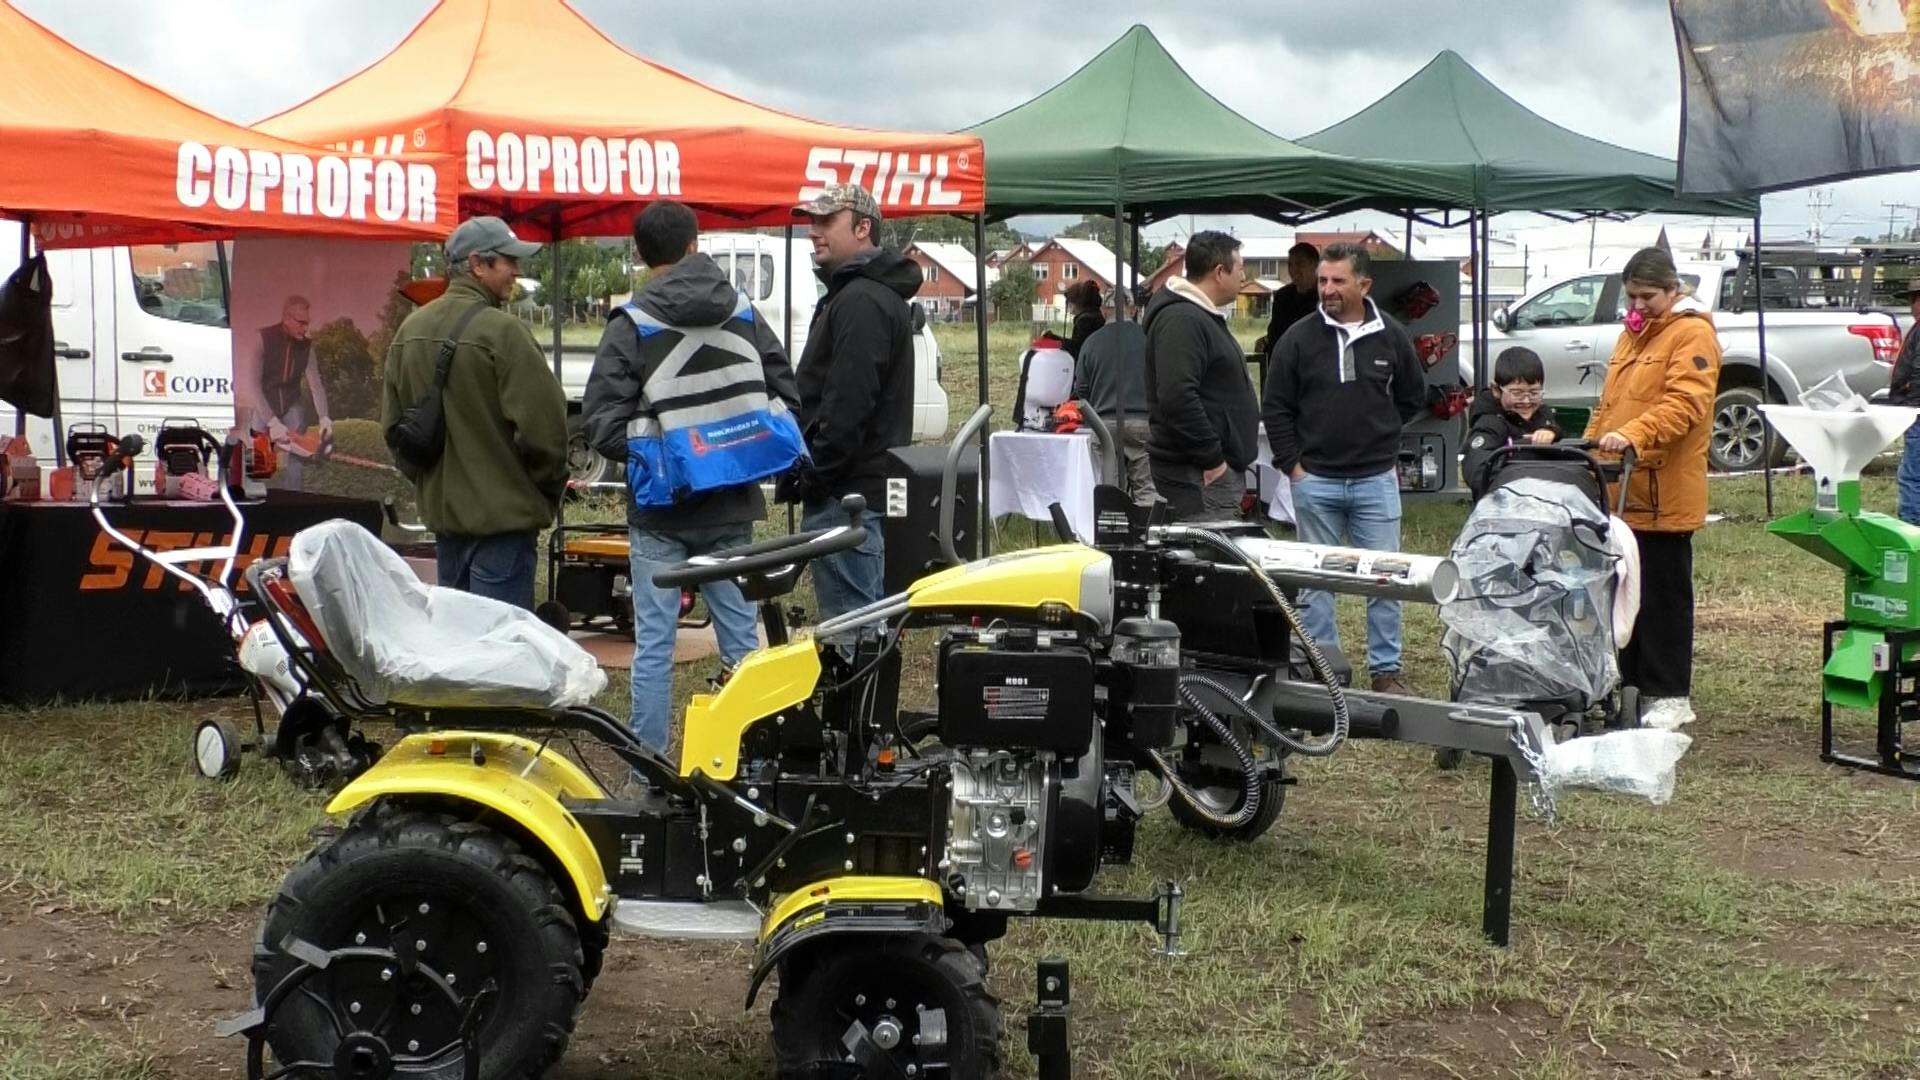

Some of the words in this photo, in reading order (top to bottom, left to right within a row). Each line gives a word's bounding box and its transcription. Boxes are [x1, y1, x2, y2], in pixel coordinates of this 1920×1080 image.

[176, 142, 437, 223] COPROFOR
[466, 129, 682, 196] COPROFOR
[798, 146, 962, 206] STIHL
[171, 376, 234, 394] COPR
